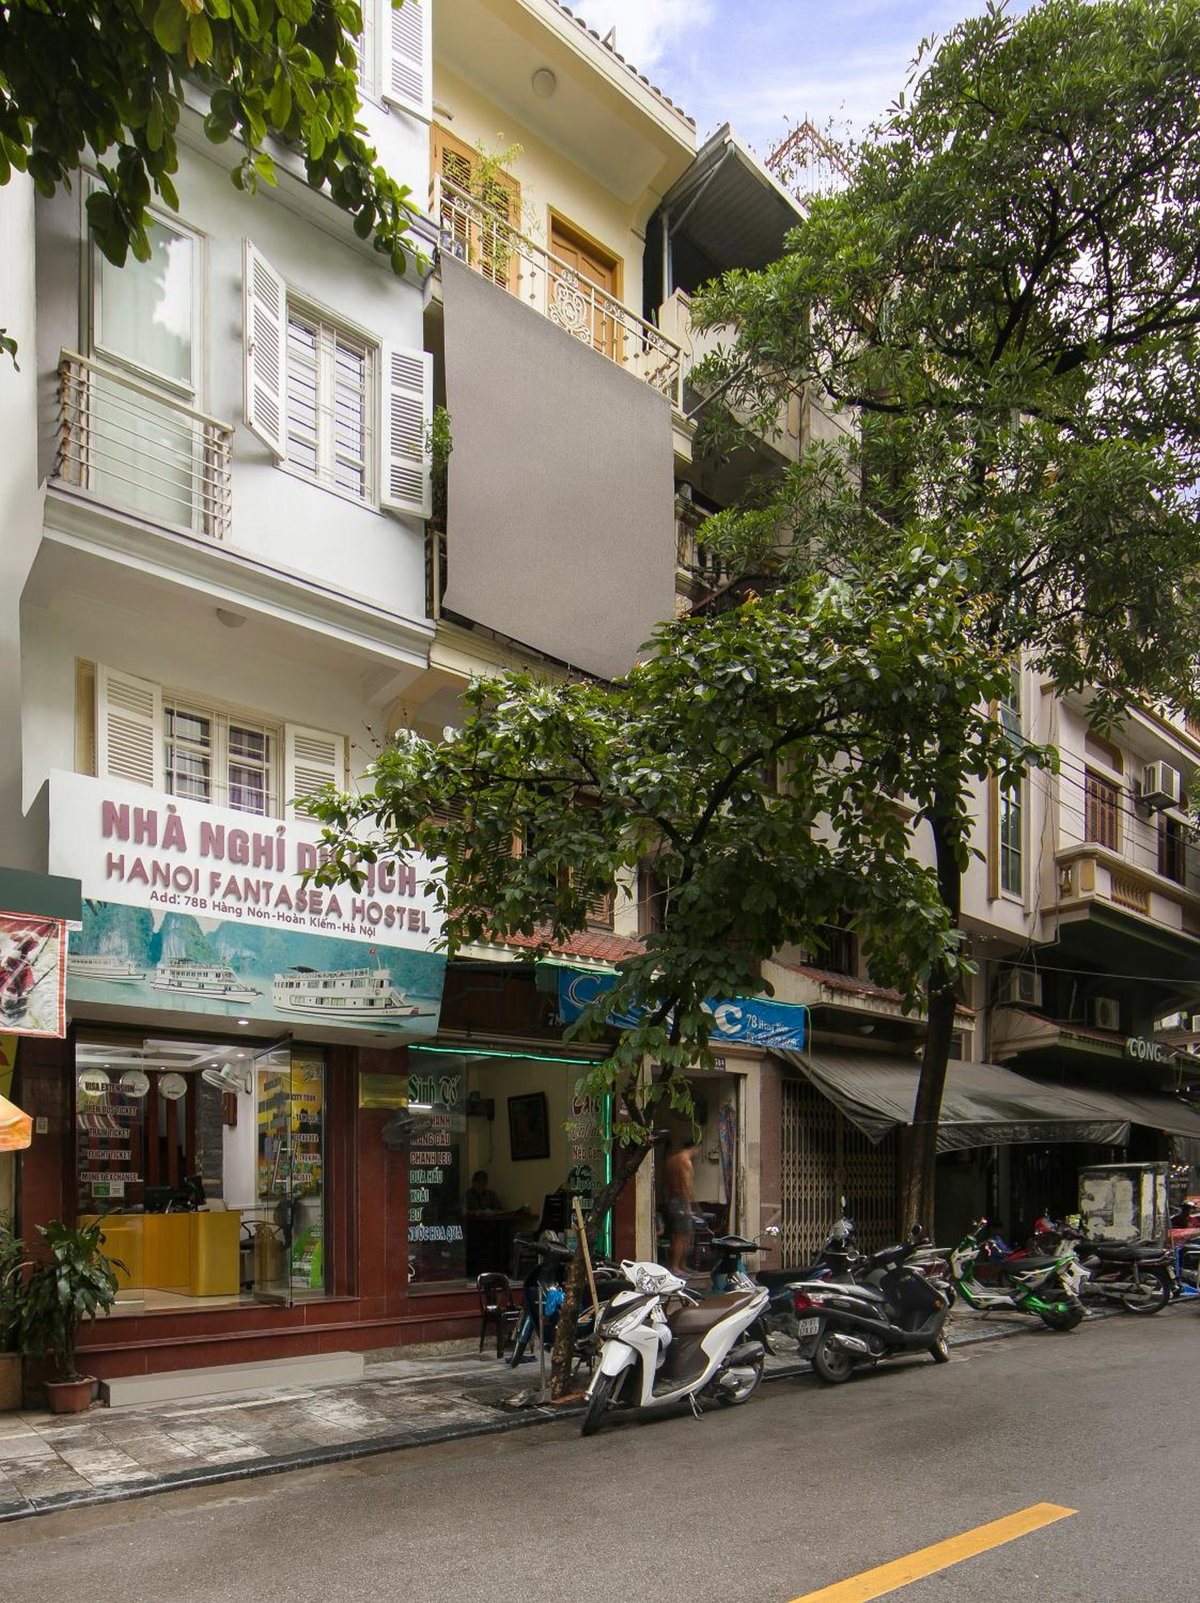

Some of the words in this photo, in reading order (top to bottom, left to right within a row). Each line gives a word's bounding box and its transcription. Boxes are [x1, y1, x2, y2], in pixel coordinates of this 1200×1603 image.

[102, 799, 187, 853] NHÀ
[200, 821, 286, 872] NGHỈ
[106, 851, 199, 895] HANOI
[210, 871, 343, 919] FANTASEA
[351, 897, 431, 934] HOSTEL
[150, 890, 181, 905] Add:
[184, 895, 208, 909] 78B
[212, 901, 243, 918] Hàng
[85, 1082, 99, 1092] VISA
[101, 1083, 135, 1093] EXTENSION
[408, 1074, 435, 1104] Sinh
[115, 1105, 137, 1116] TICKET
[410, 1152, 436, 1165] CHANH
